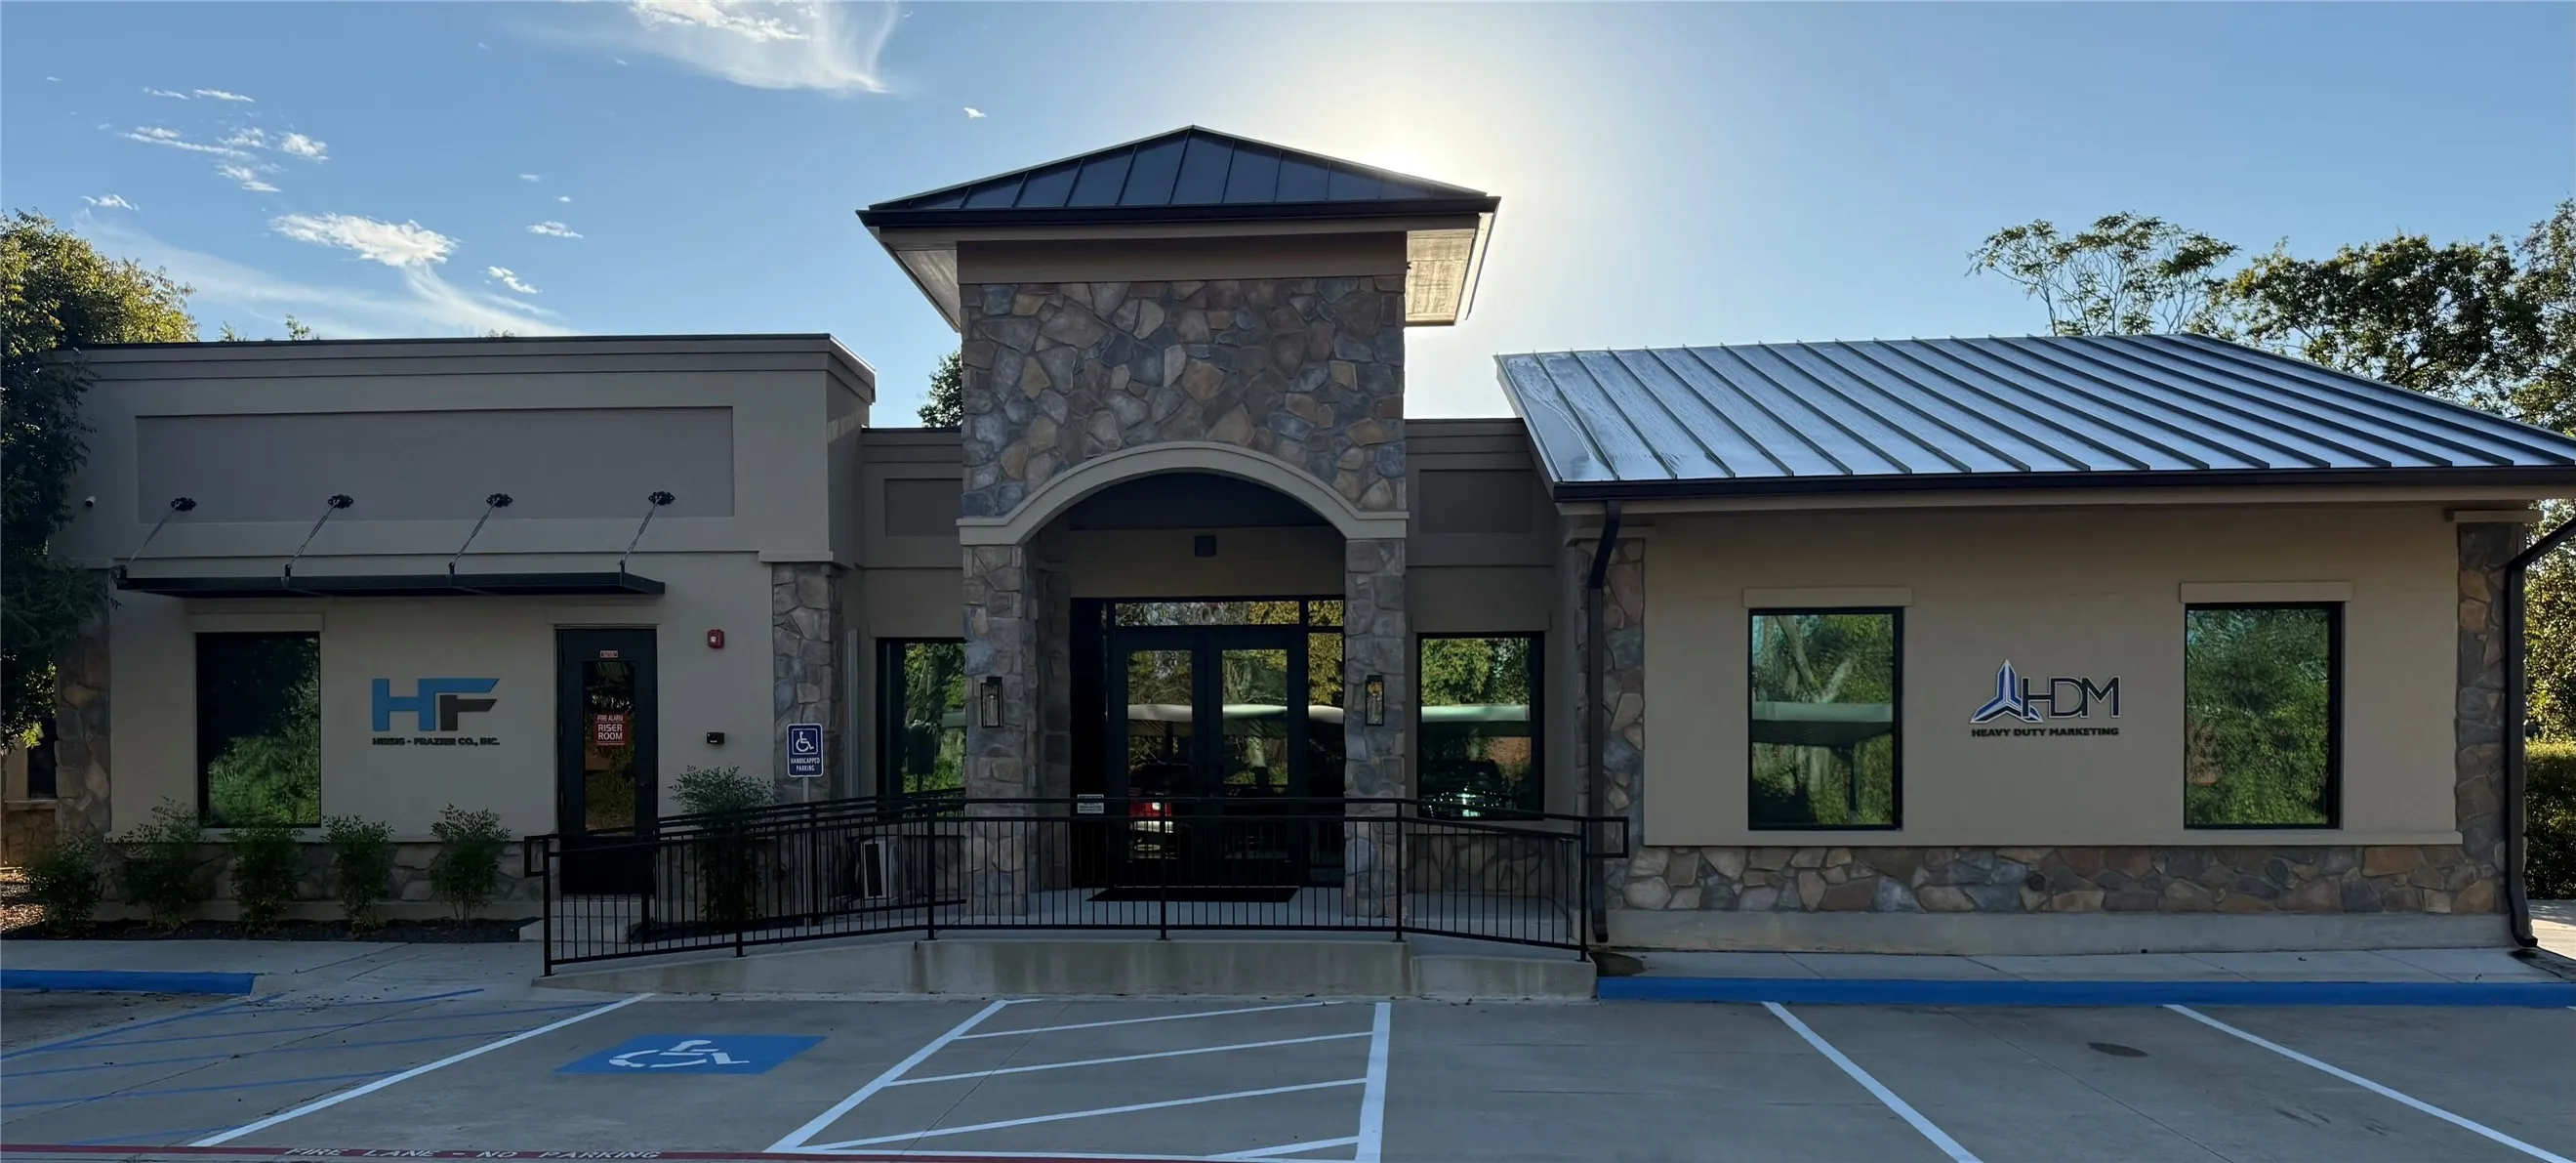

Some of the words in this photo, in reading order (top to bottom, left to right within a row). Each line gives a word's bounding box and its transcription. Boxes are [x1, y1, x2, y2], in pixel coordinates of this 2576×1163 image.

[2022, 676, 2120, 718] HDM
[372, 678, 500, 731] HF
[2014, 728, 2046, 737] DUTY
[2049, 727, 2119, 736] MARKETING
[414, 737, 457, 746] FRAZIER
[480, 737, 500, 746] INC.
[284, 1147, 348, 1156] FIRE
